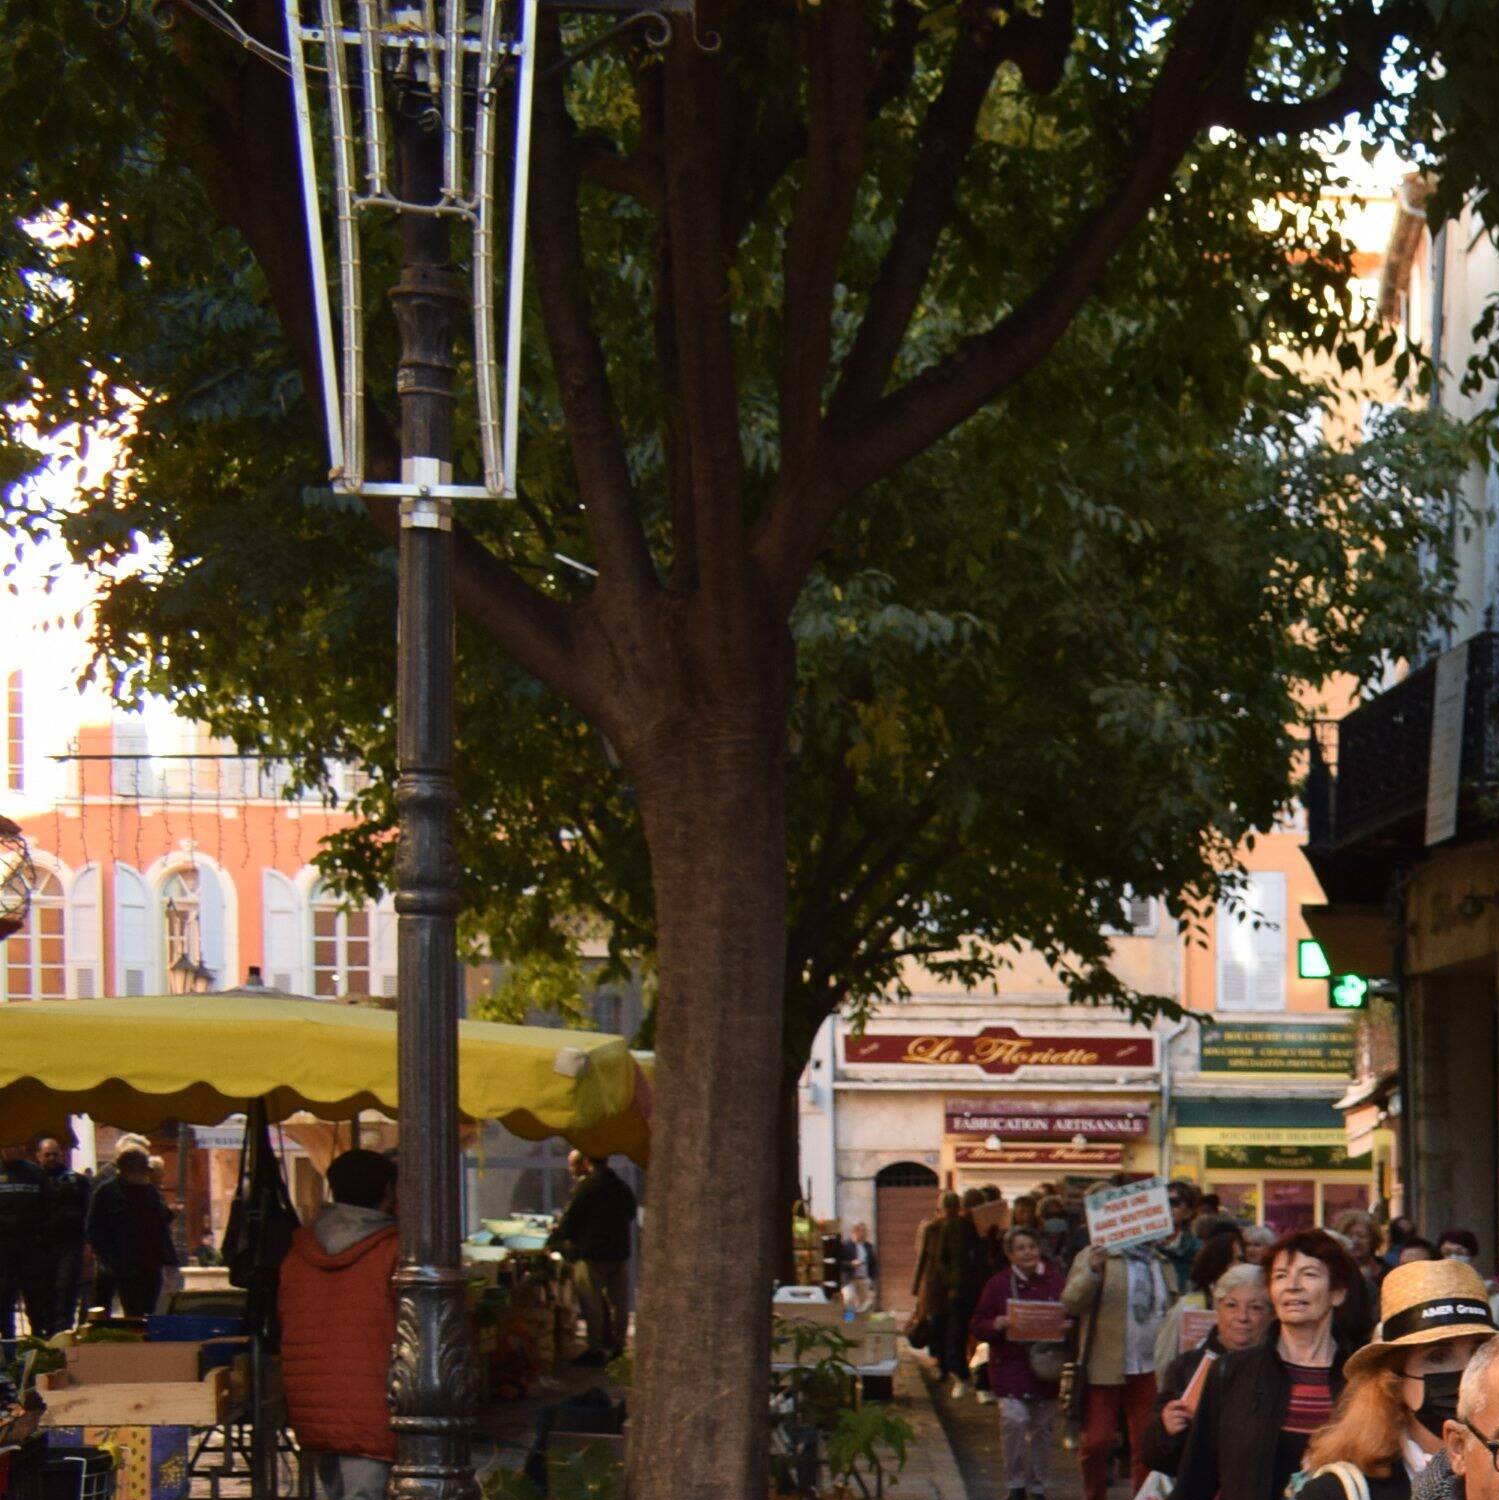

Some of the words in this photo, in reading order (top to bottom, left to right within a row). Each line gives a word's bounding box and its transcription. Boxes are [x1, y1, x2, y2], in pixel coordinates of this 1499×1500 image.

[902, 1035, 961, 1064] La
[967, 1035, 1099, 1065] Floriette
[953, 1117, 1049, 1131] FABRICATION
[1053, 1118, 1144, 1133] ARTISANALE
